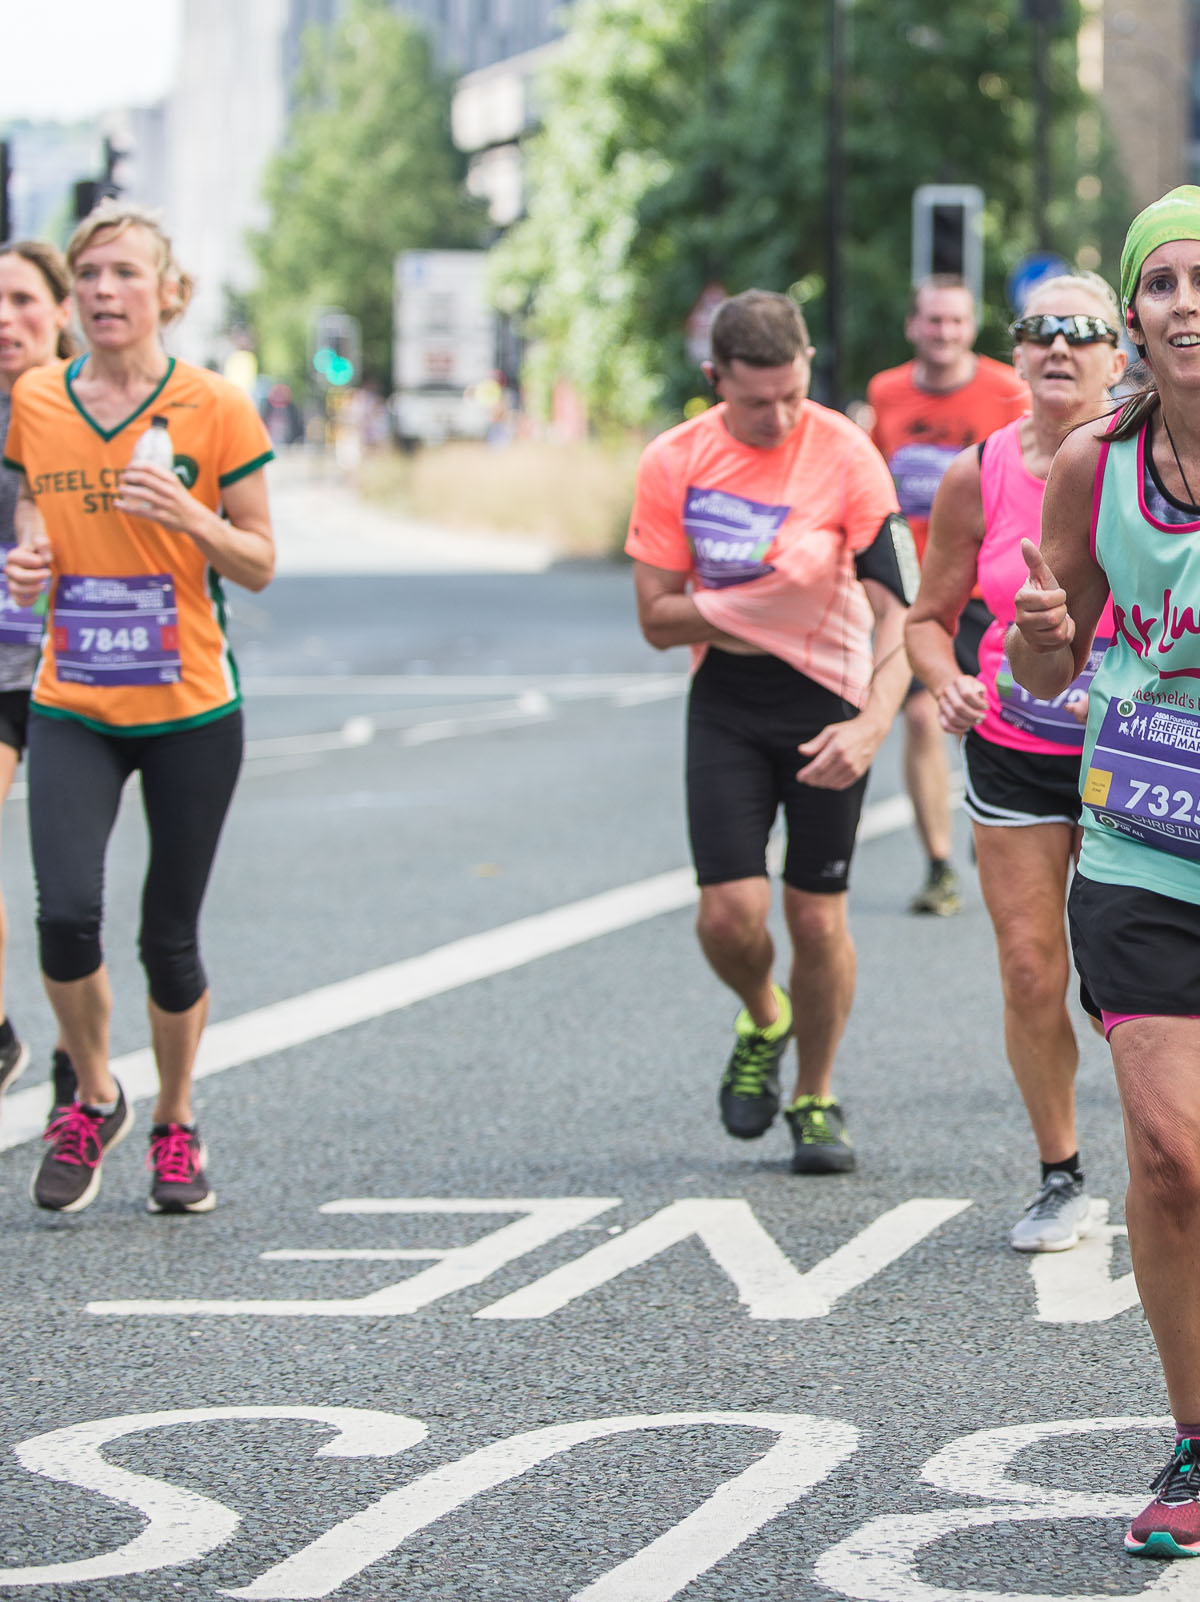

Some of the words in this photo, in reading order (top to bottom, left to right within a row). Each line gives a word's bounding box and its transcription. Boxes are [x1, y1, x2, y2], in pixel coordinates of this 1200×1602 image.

[34, 470, 93, 494] STEEL
[79, 626, 149, 652] 7848
[1170, 714, 1199, 727] Foundation
[1147, 730, 1177, 746] HALF
